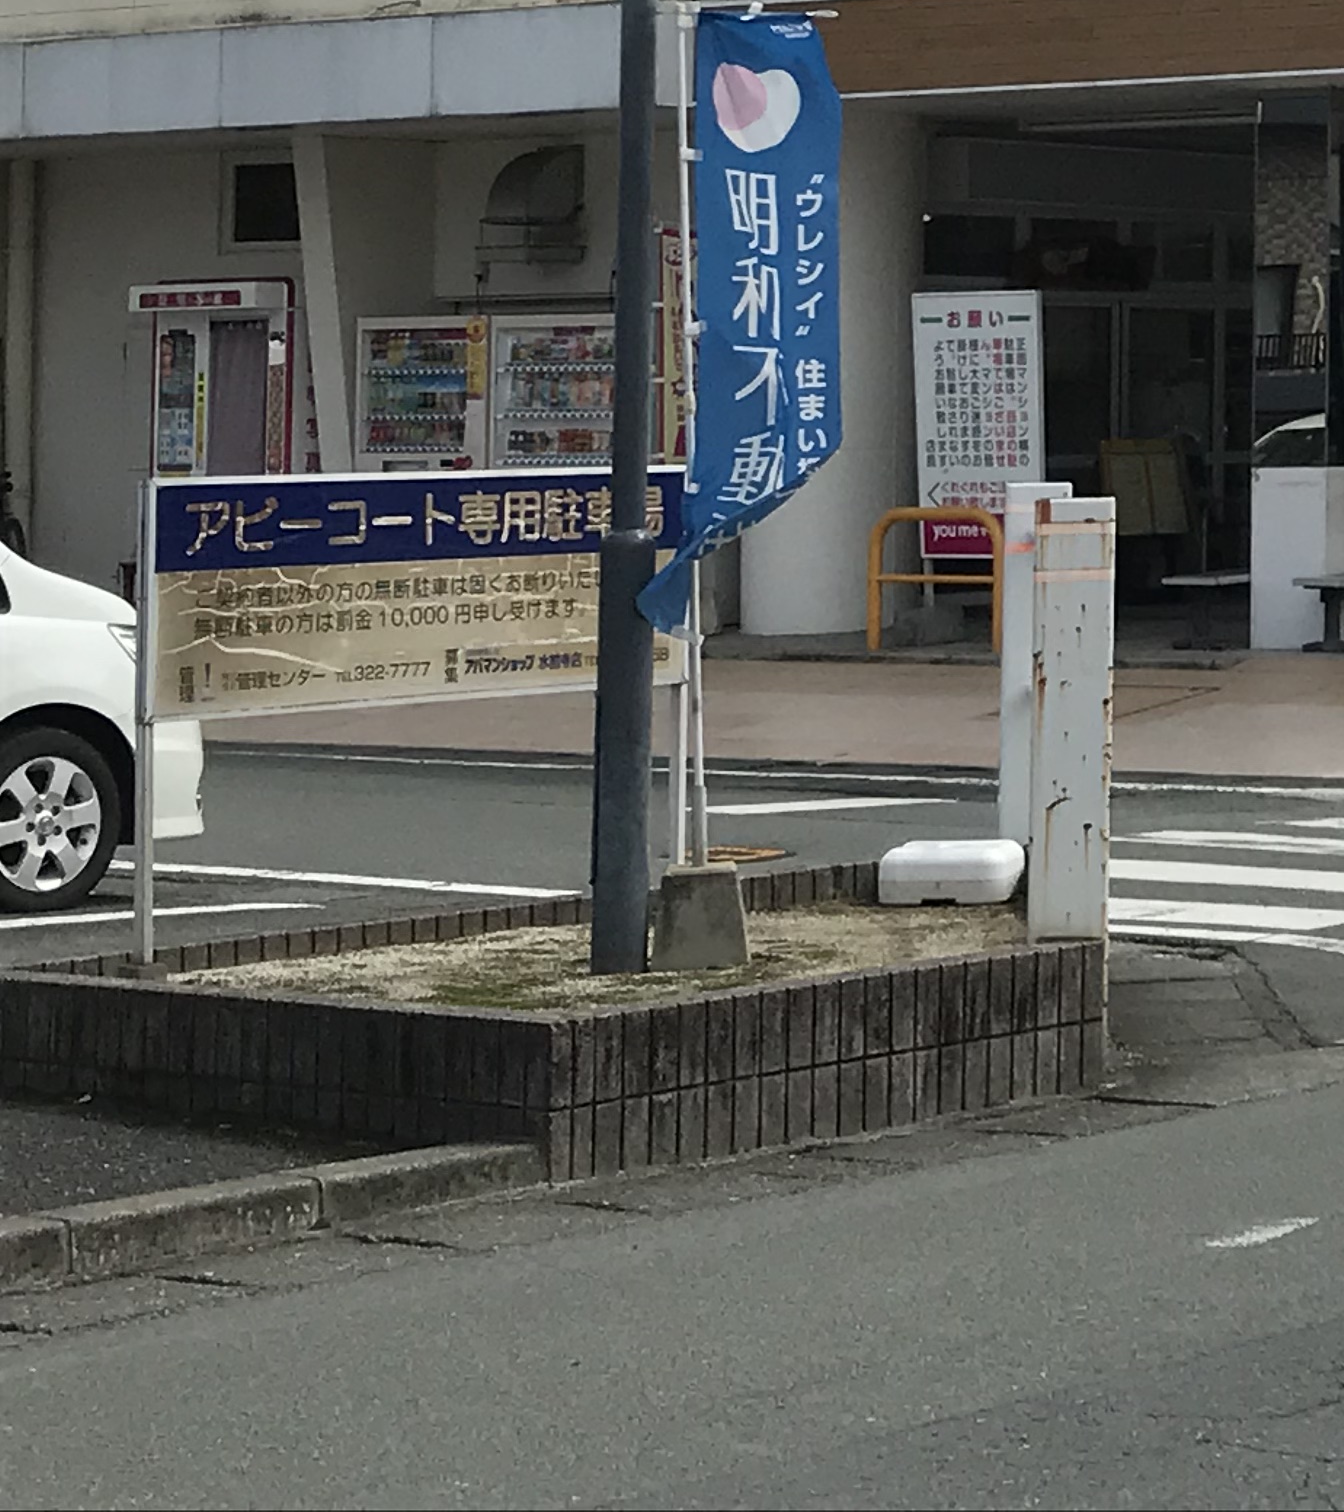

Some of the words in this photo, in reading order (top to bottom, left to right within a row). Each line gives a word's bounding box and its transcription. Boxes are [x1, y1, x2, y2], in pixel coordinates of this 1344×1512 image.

[712, 167, 784, 533] 明和不動
[946, 310, 1004, 328] お願い
